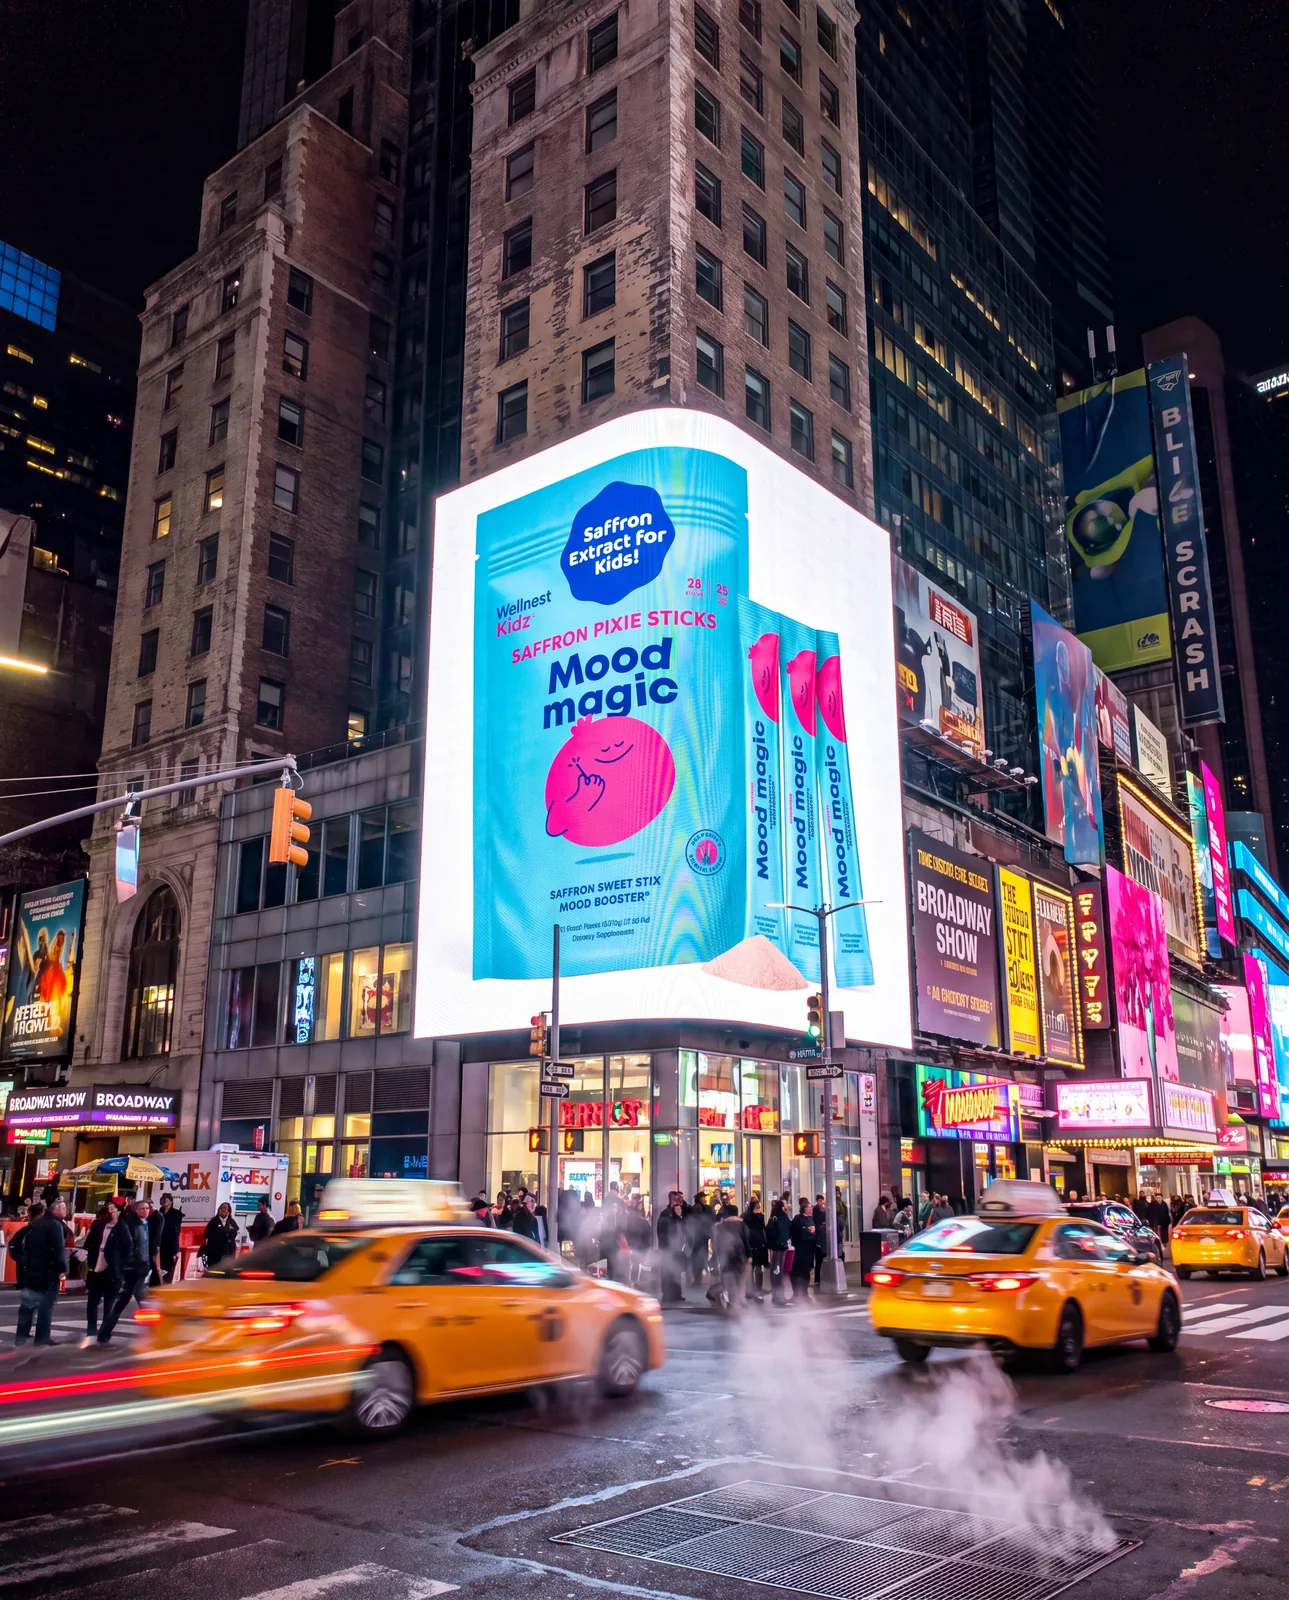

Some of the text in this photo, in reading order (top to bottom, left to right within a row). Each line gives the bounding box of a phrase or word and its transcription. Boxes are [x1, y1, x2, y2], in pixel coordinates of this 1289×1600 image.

[583, 511, 653, 543] Saffron
[568, 527, 668, 567] Extract for
[594, 549, 640, 576] Kids!
[687, 577, 702, 589] 28
[496, 589, 552, 620] Wellnest
[1175, 540, 1209, 693] SCRASH
[496, 612, 531, 638] Kidz
[511, 610, 717, 665] SAFFRON PIXIE STICKS
[547, 636, 673, 695] Mood
[542, 671, 679, 730] magic
[752, 720, 769, 880] Mood magic
[791, 735, 808, 889] Mood magic
[824, 745, 850, 898] Mood magic
[549, 875, 661, 900] SAFFRON SWEET STIX
[559, 898, 592, 913] MOOD
[1002, 881, 1016, 905] THE
[917, 880, 992, 936] BROADWAY
[936, 922, 978, 964] SHOW
[9, 1092, 87, 1111] BROADWAY SHOW
[96, 1093, 173, 1109] BROADWAY
